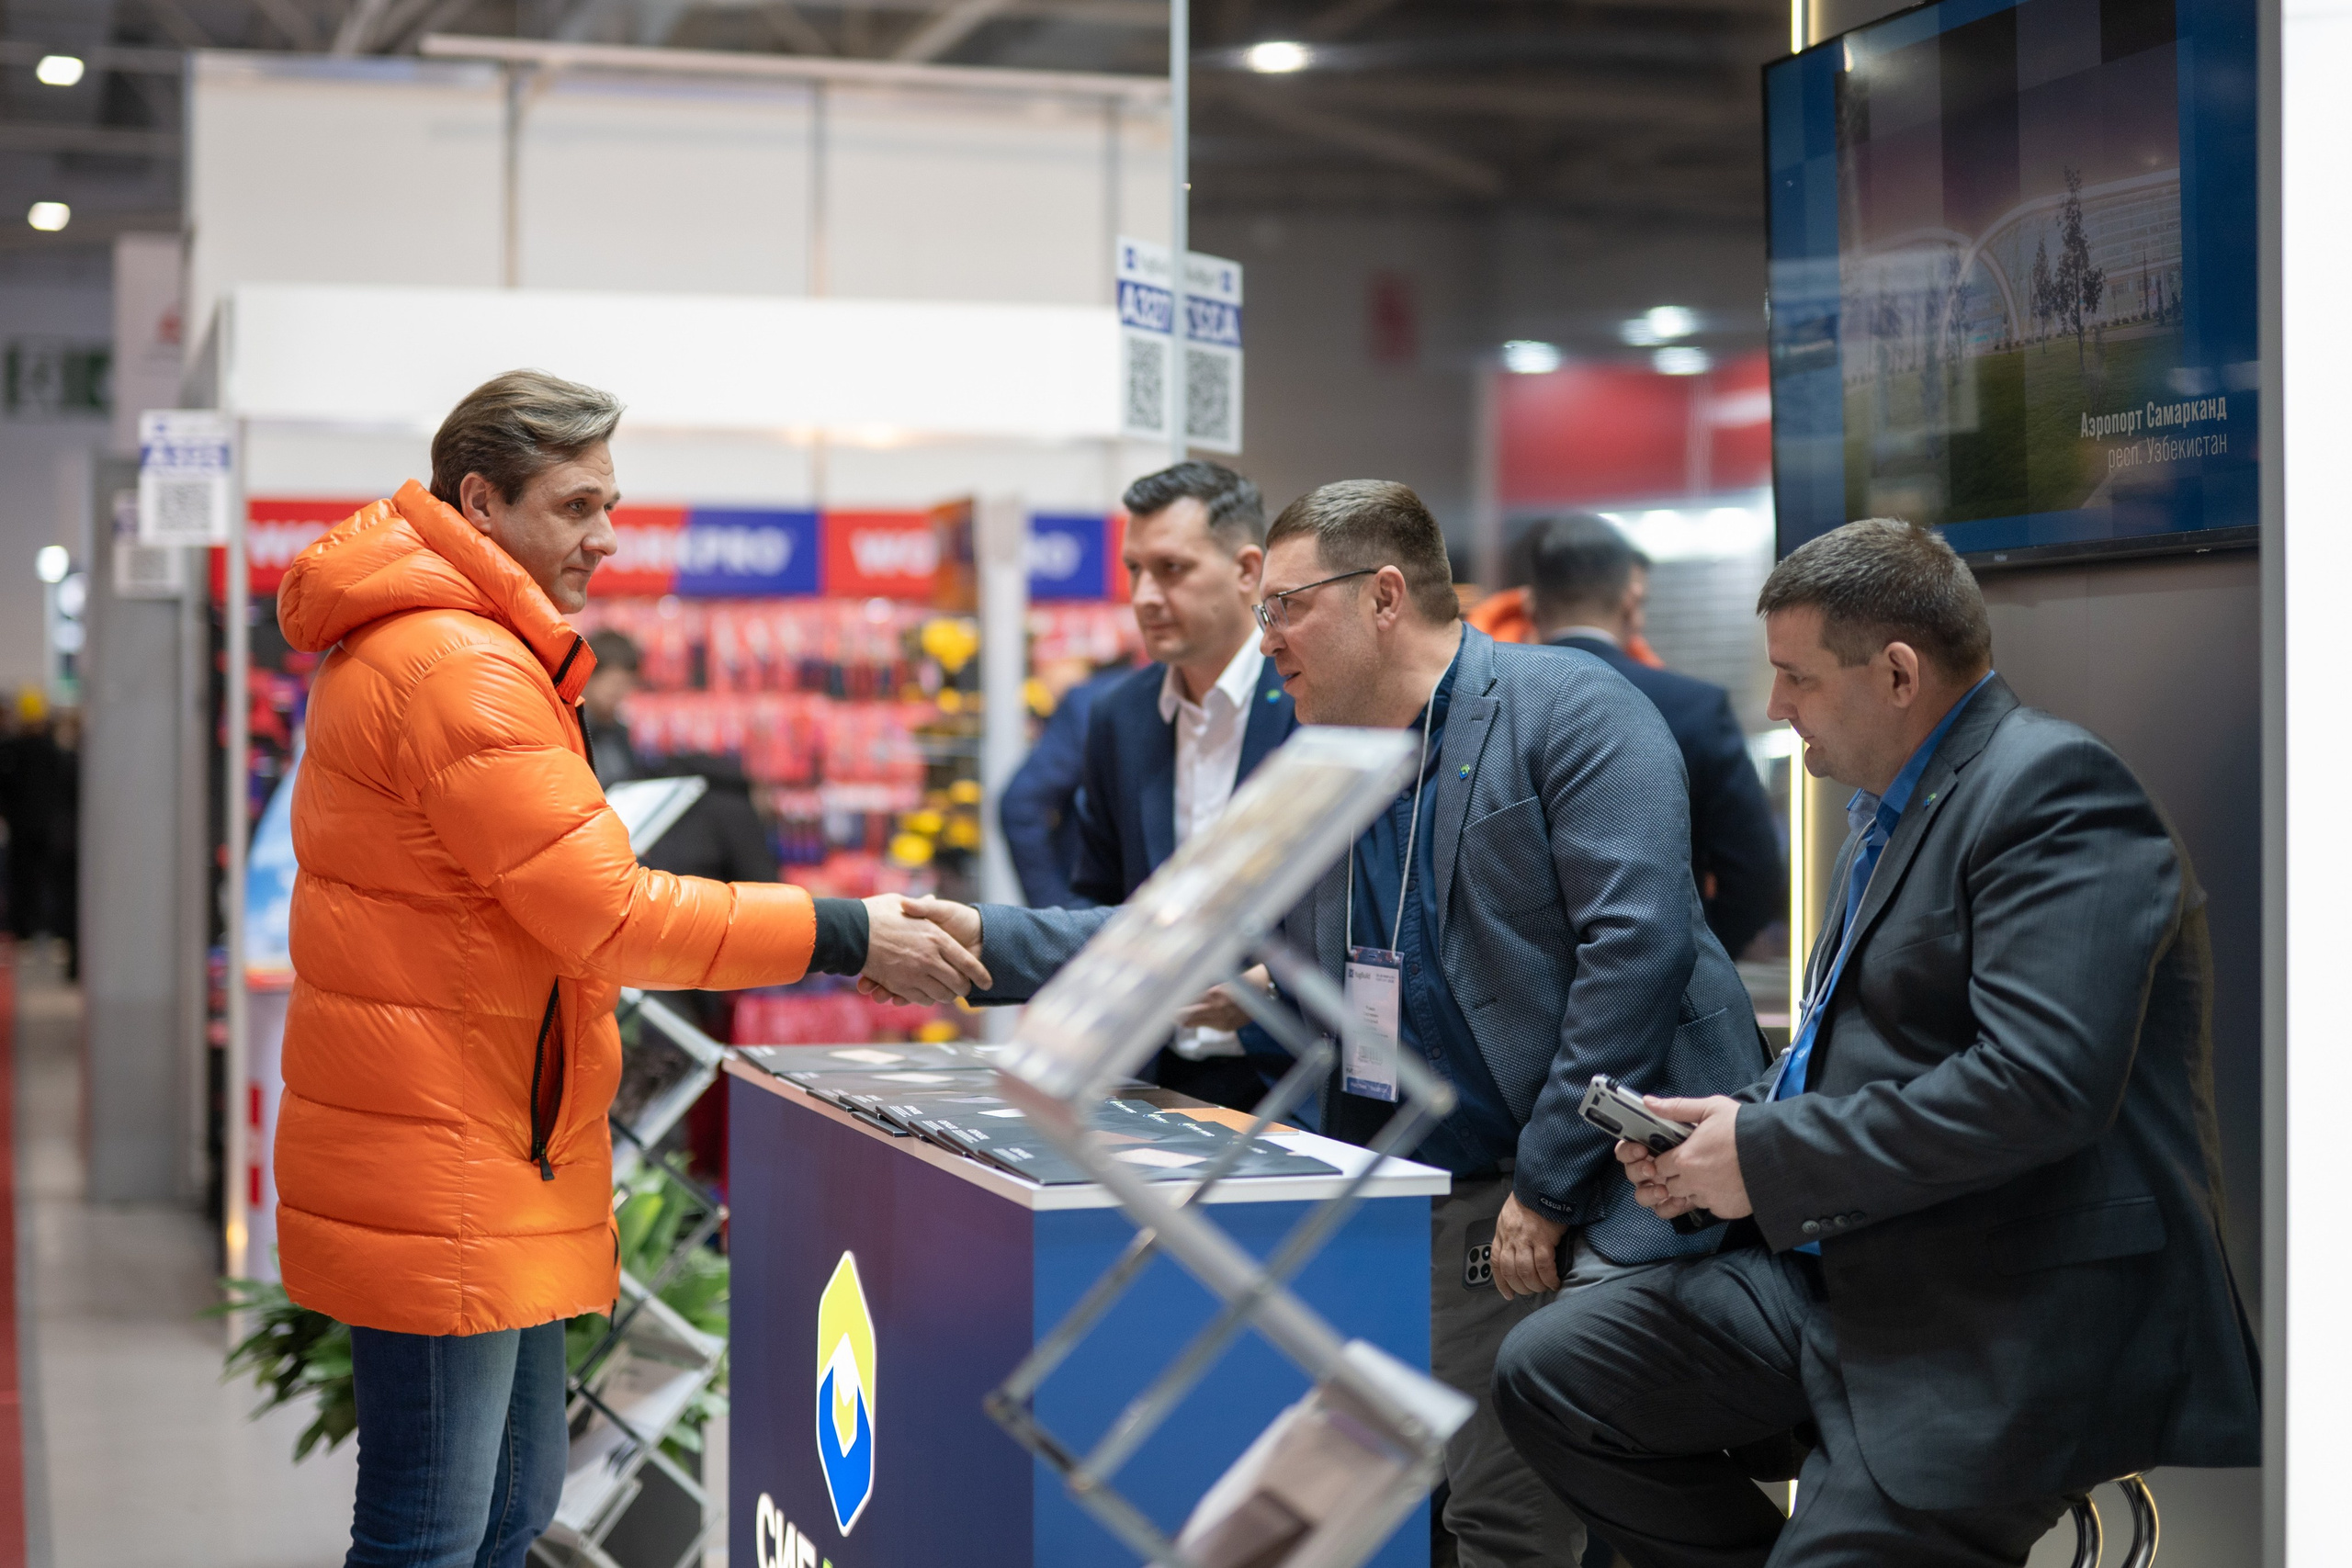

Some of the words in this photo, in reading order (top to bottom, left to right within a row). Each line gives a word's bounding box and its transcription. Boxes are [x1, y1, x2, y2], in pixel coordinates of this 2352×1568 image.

[2080, 410, 2143, 441] Аэропорт
[2146, 396, 2228, 429] Самарканд
[2108, 445, 2143, 473] респ.
[2146, 433, 2227, 463] Узбекистан
